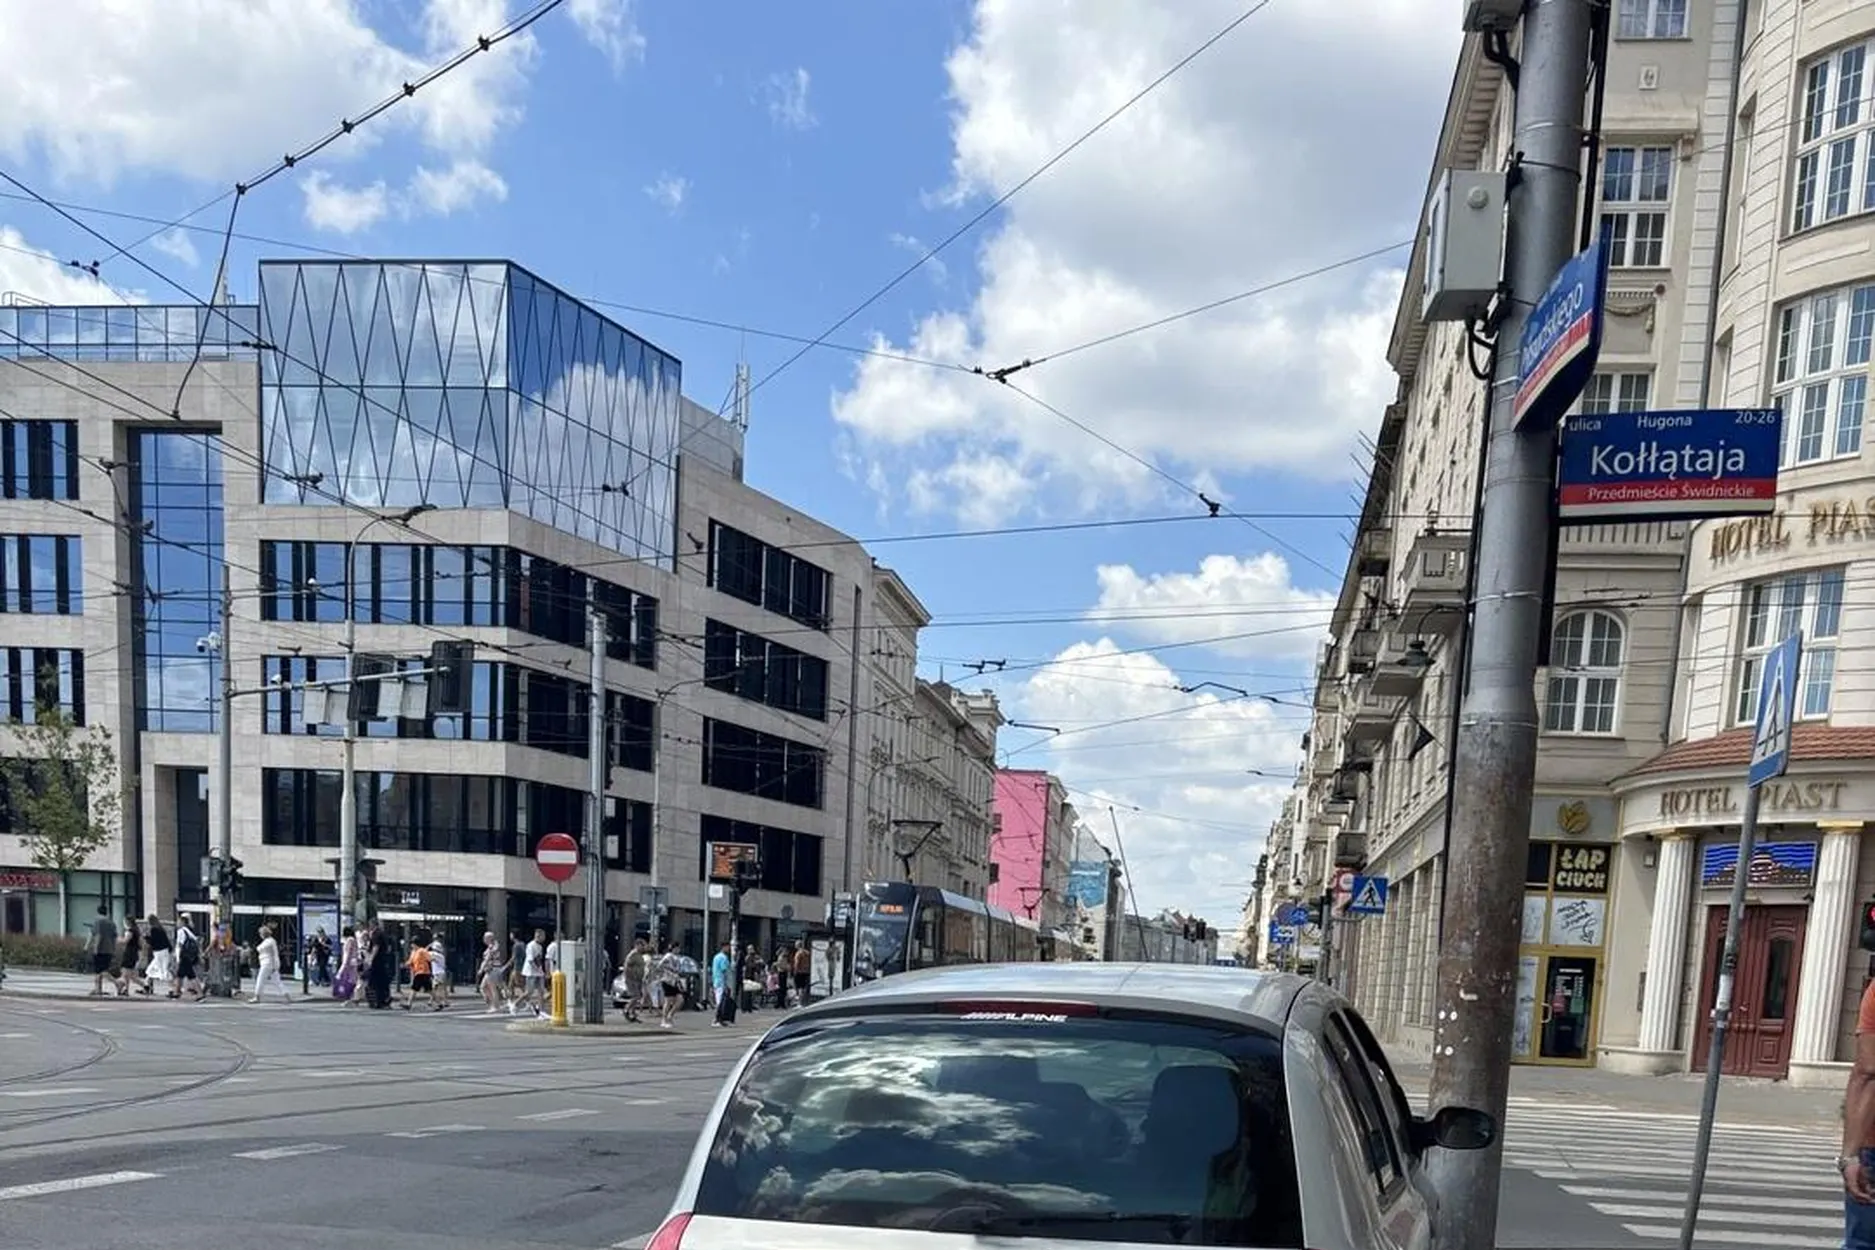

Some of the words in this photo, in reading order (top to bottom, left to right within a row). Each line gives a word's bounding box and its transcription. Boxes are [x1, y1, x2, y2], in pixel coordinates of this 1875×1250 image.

[1568, 418, 1602, 431] ulica
[1637, 415, 1693, 430] Hugona
[1735, 411, 1776, 424] 20-26
[1591, 440, 1746, 480] Kołłątaja
[1588, 486, 1678, 501] Przedmieście
[1682, 483, 1756, 499] Świdnickie
[1710, 510, 1791, 561] HOTEL
[1659, 786, 1738, 816] HOTEL
[1560, 848, 1605, 870] ŁAP
[1556, 871, 1606, 888] CIUCH
